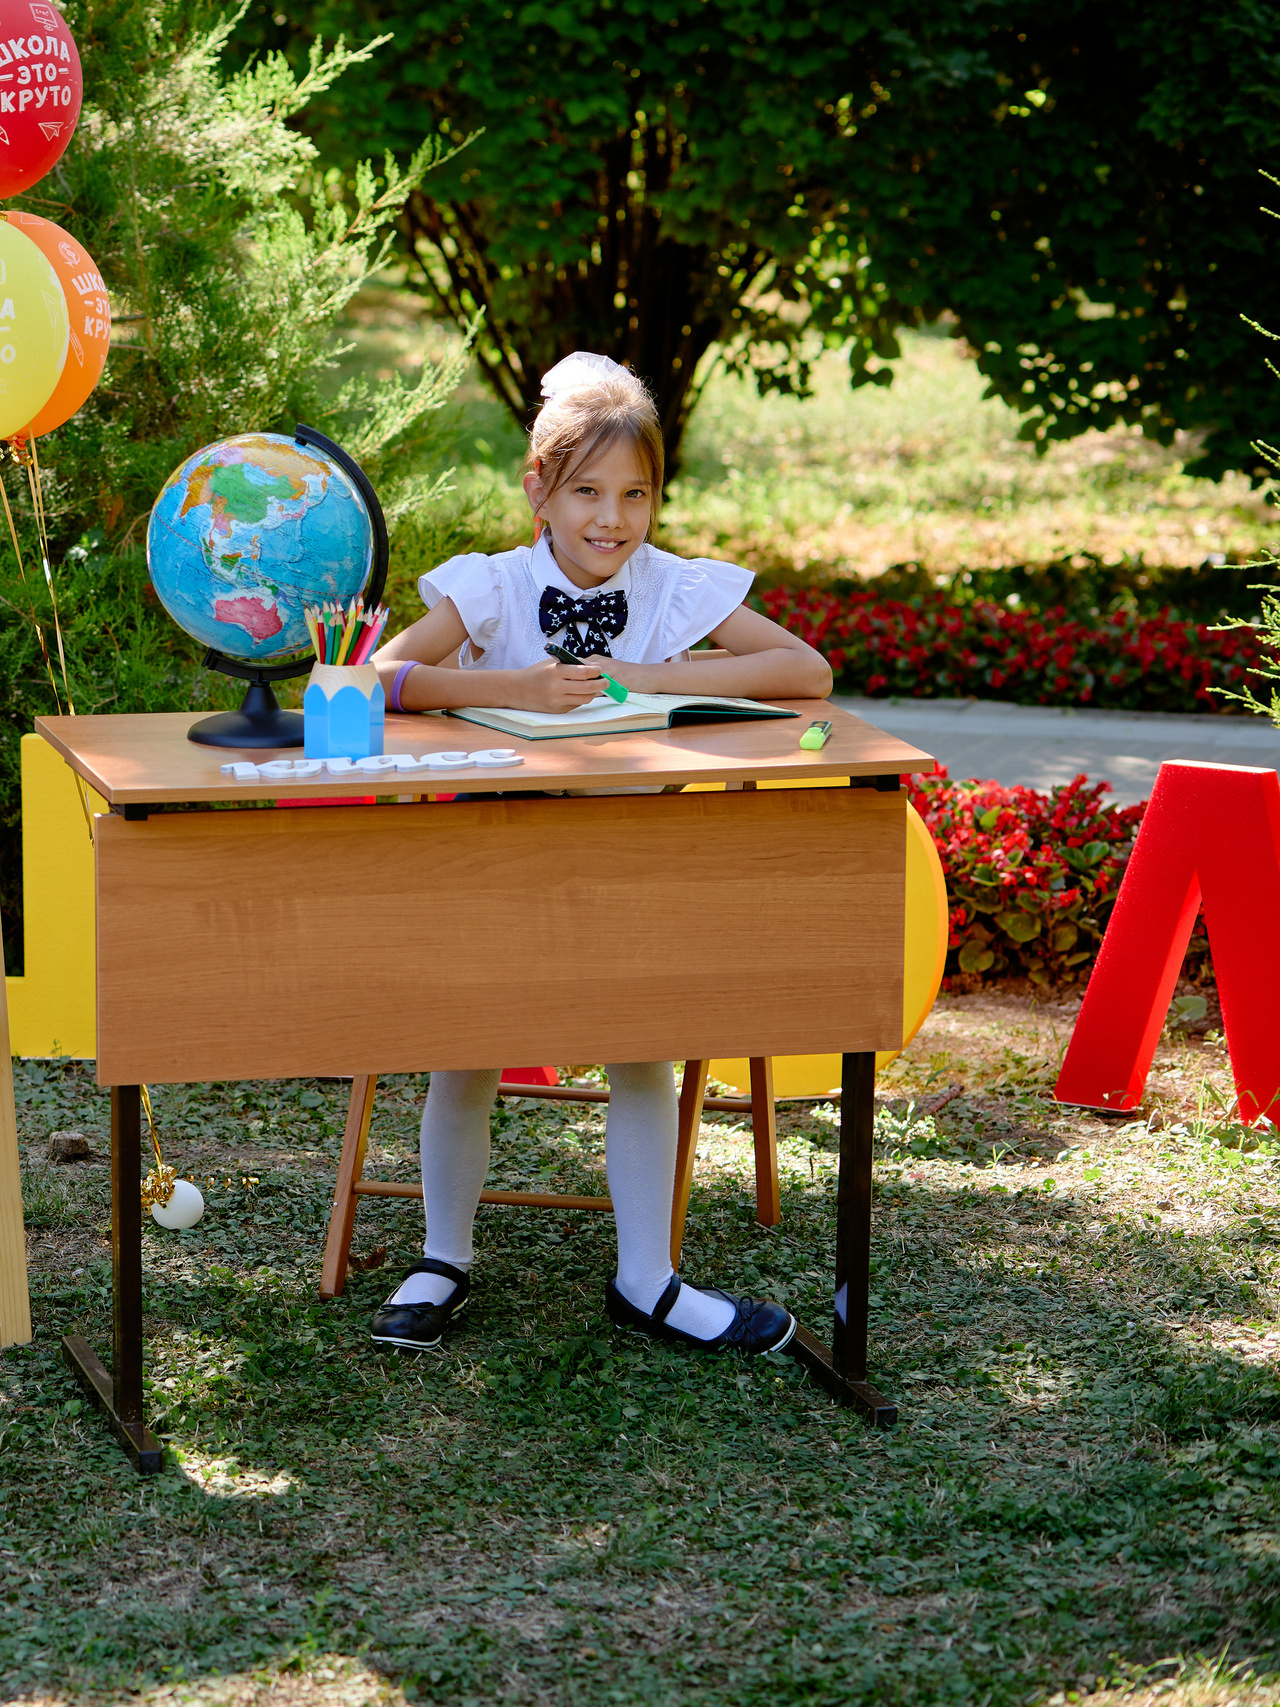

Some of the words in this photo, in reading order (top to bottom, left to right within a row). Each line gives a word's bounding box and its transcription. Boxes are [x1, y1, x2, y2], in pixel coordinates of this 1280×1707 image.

[0, 85, 71, 113] КРУТО
[71, 272, 108, 296] ШКО
[84, 315, 111, 340] КРУ
